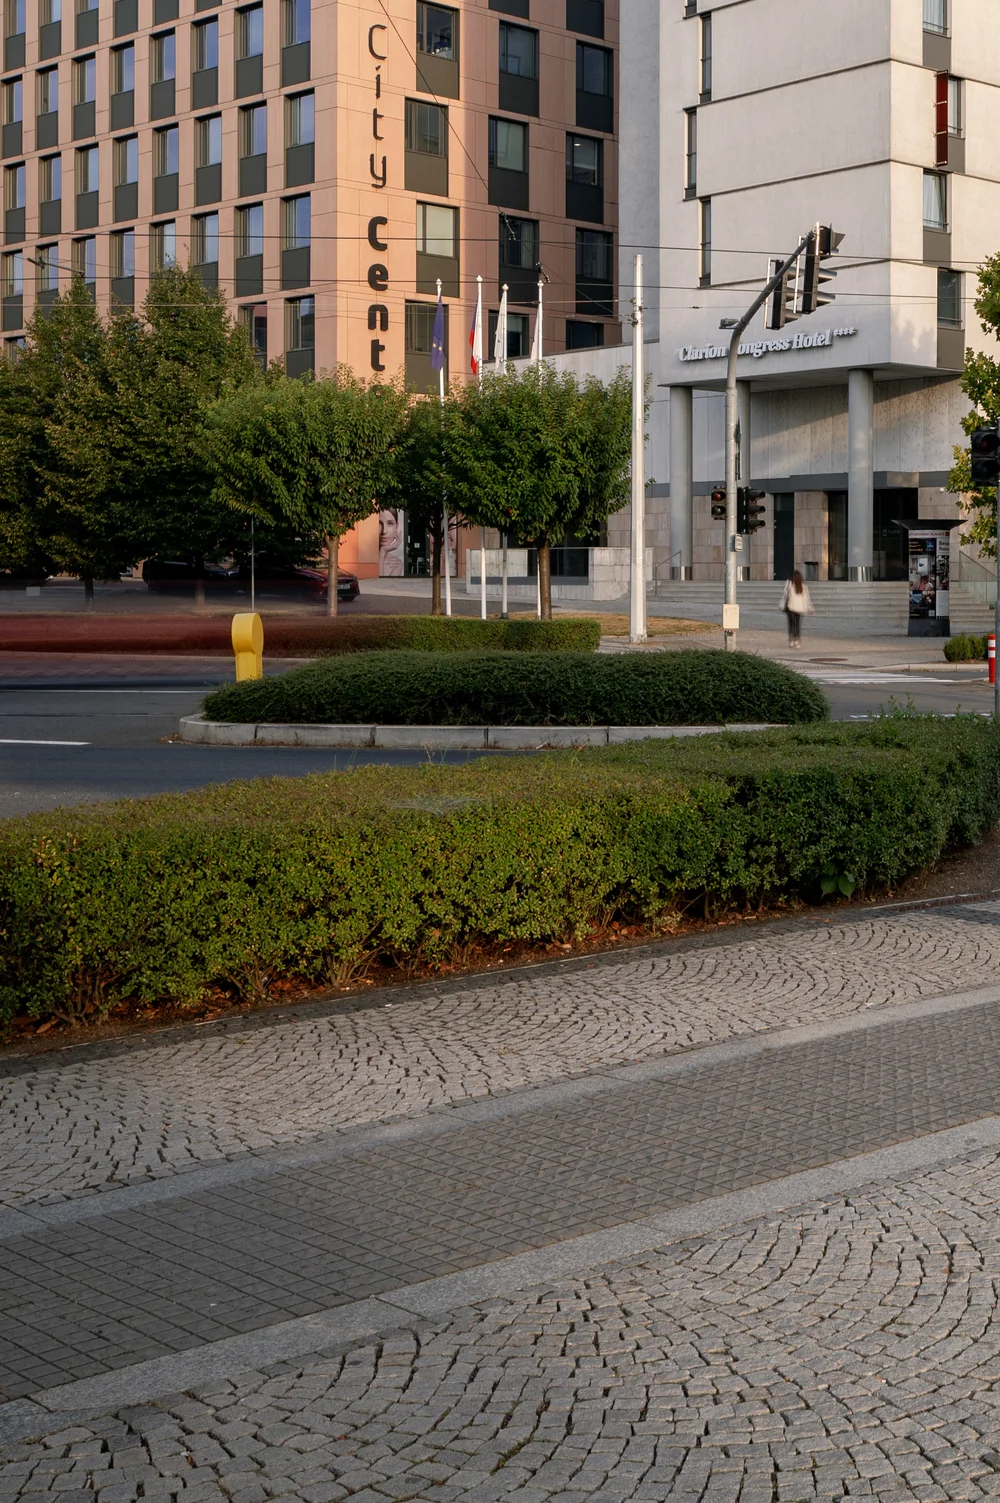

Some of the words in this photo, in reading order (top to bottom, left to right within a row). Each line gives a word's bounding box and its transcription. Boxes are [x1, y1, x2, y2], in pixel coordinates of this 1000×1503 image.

[367, 23, 389, 189] City
[678, 343, 727, 362] Clarion
[737, 338, 792, 358] ongress
[791, 329, 833, 349] Hotel
